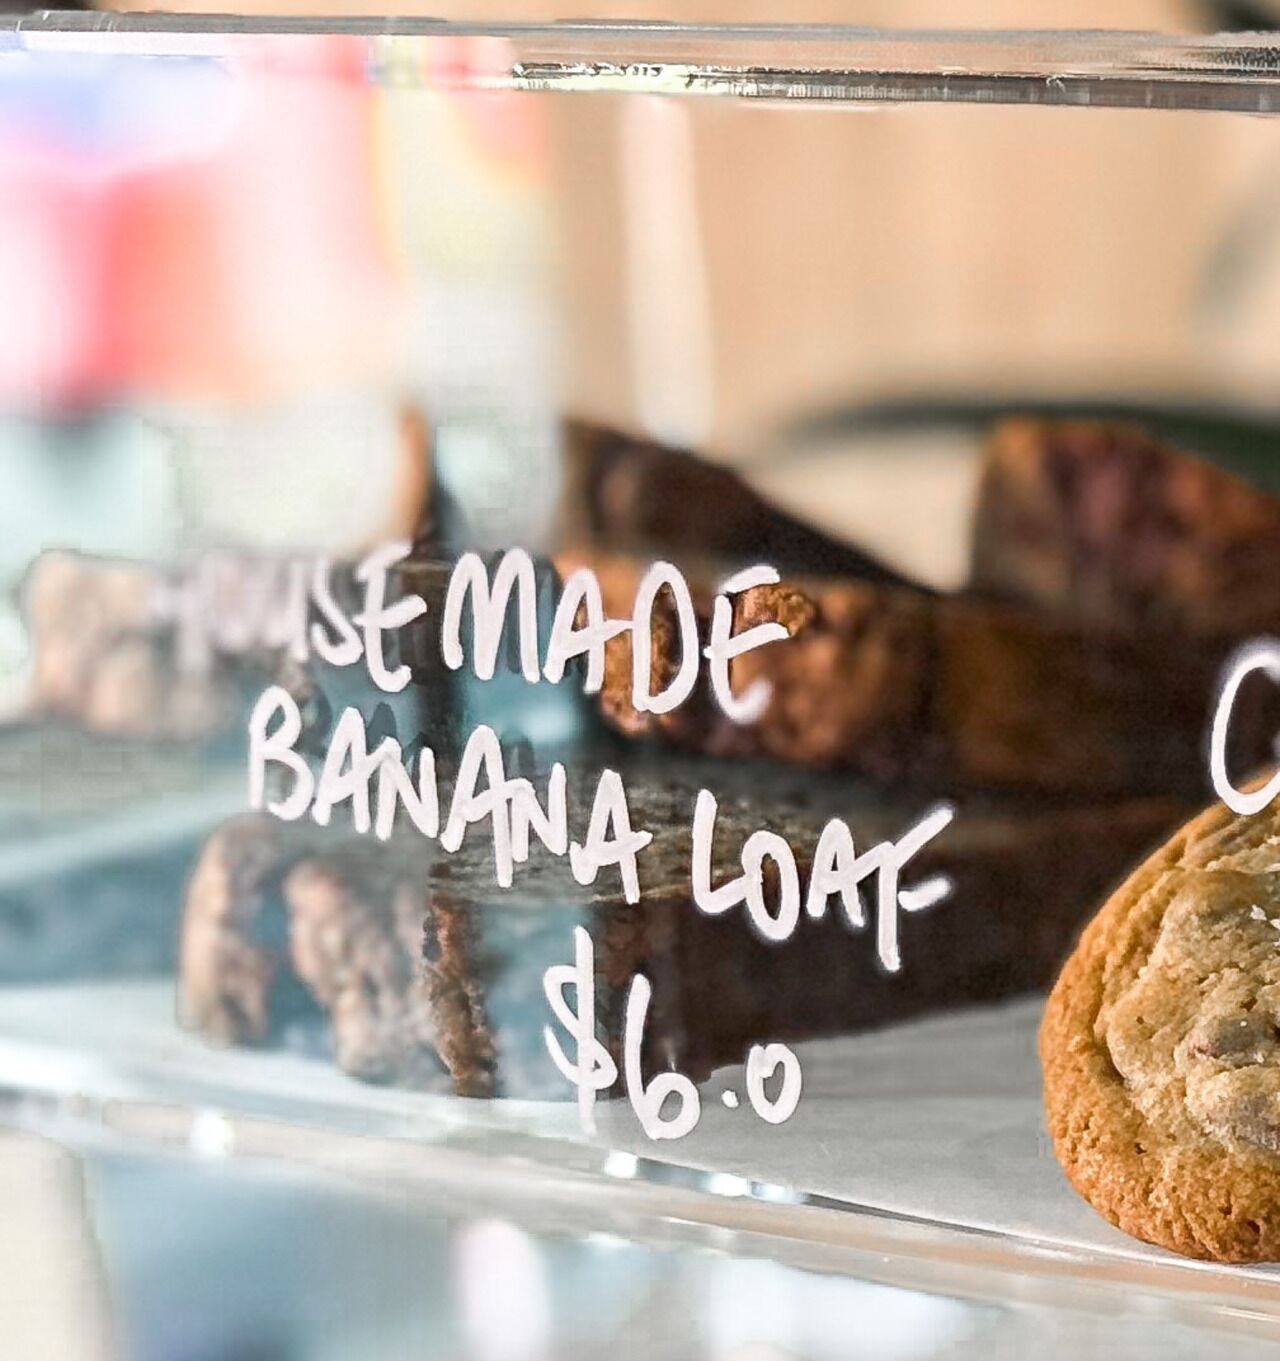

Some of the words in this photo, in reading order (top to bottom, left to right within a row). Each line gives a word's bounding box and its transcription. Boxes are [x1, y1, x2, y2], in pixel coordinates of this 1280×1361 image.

[248, 685, 652, 890] BANANA
[692, 788, 955, 973] LOAF
[543, 924, 803, 1141] $6.0
